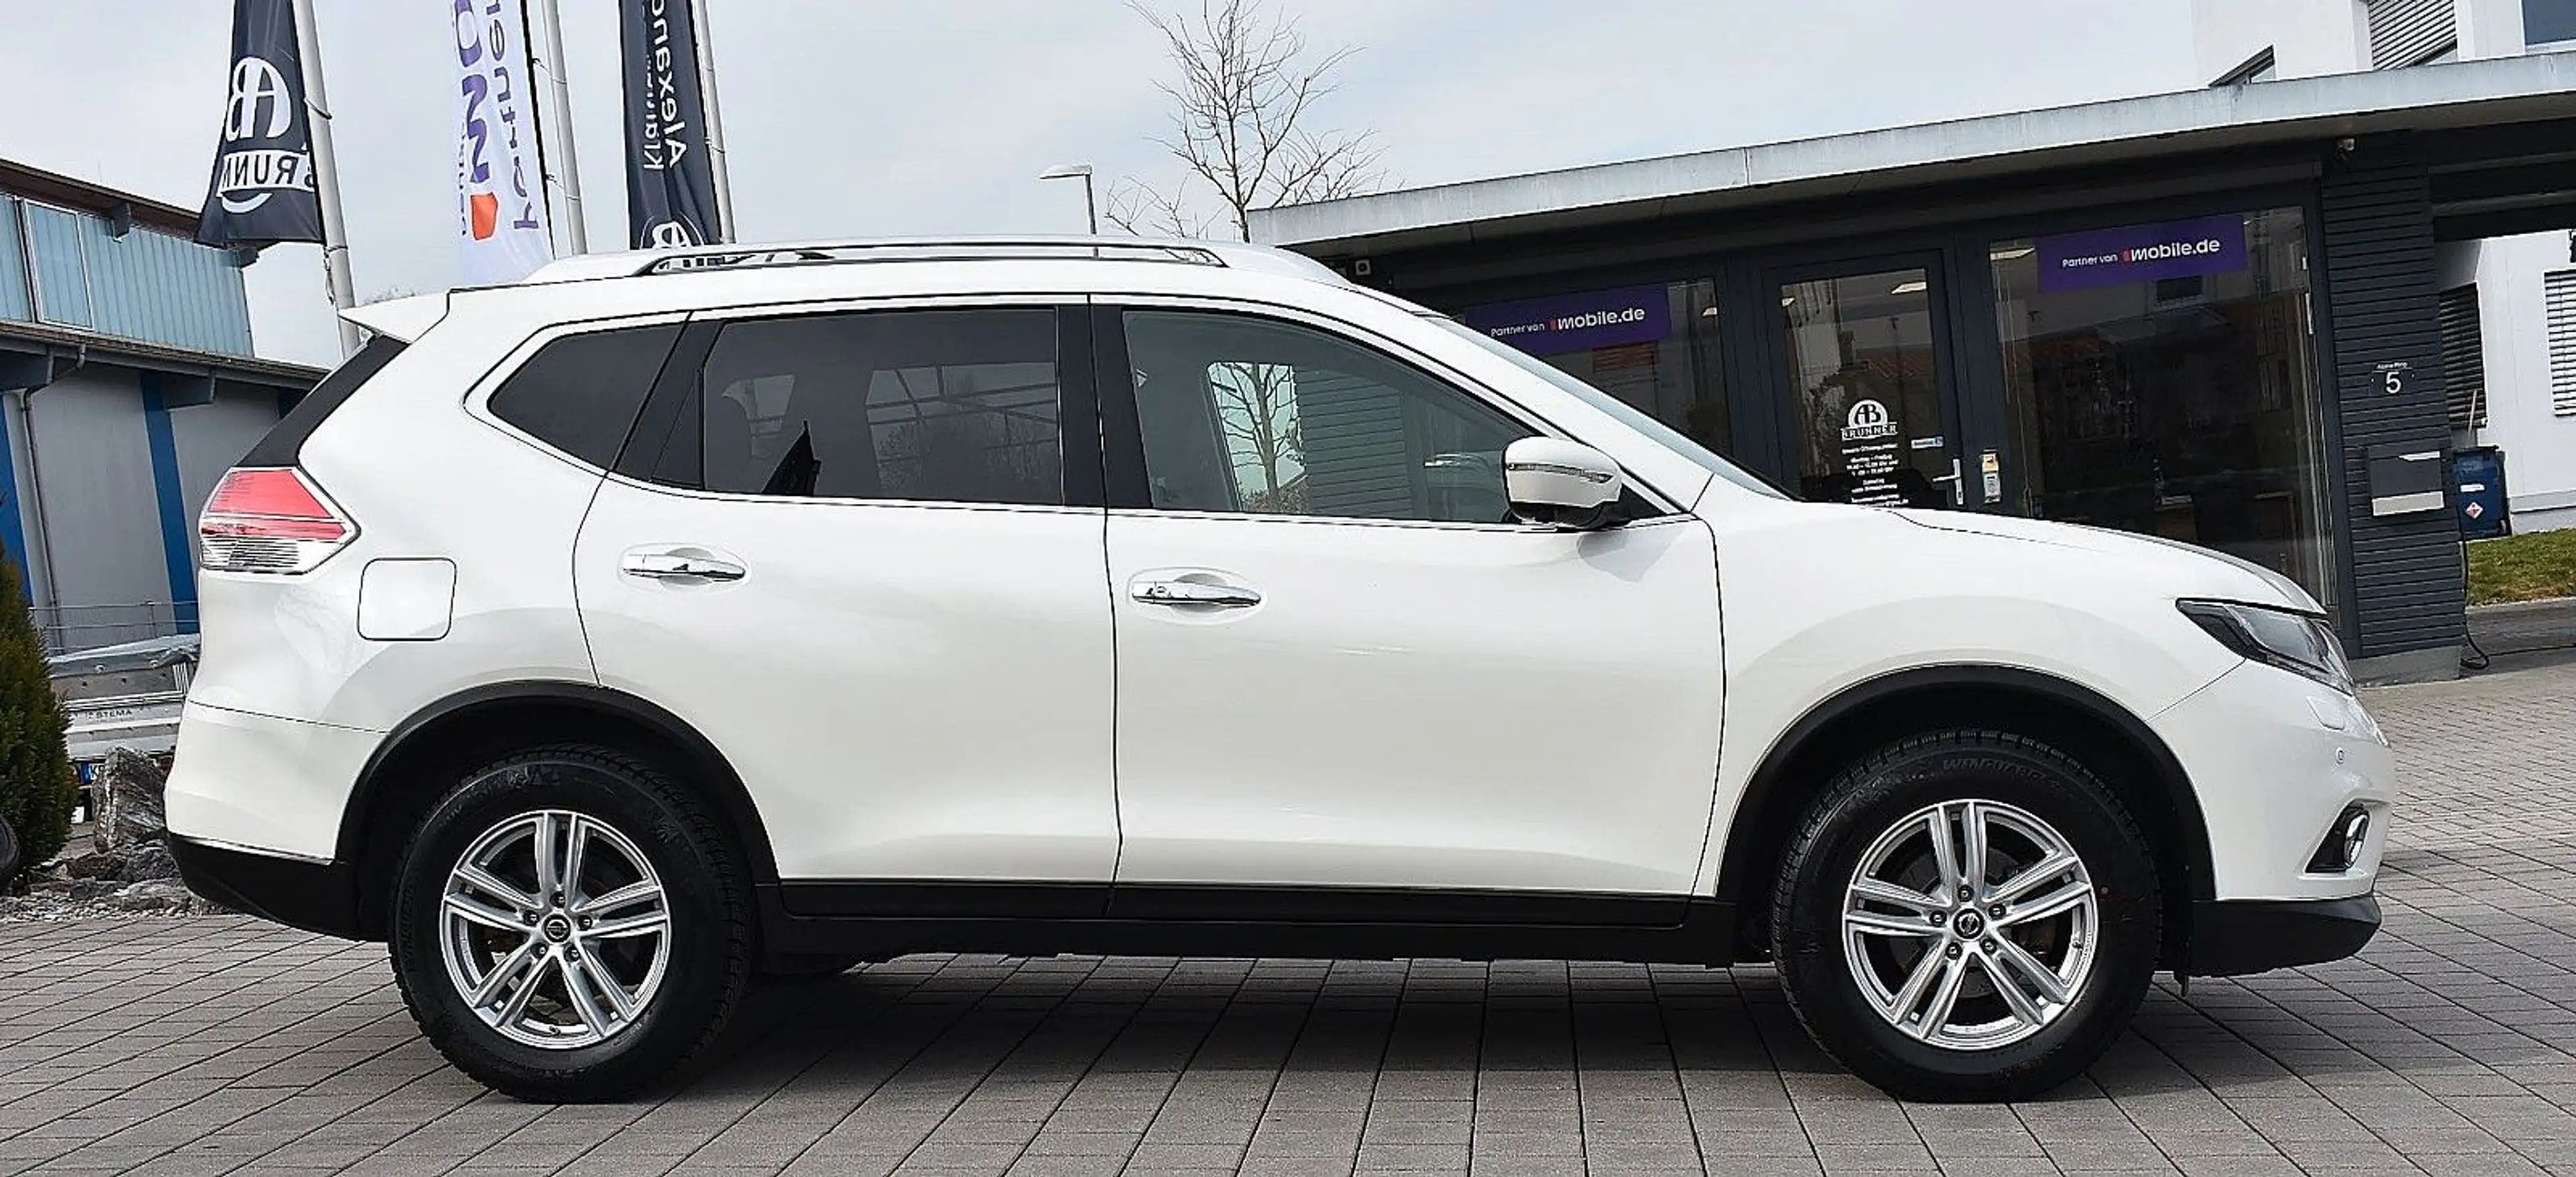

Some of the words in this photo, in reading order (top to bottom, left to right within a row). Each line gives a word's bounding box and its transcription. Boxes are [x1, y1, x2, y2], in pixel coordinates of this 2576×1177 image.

[2062, 257, 2098, 268] Partner
[2100, 254, 2118, 264] von
[2131, 239, 2220, 262] mobile.de
[1491, 325, 1525, 337] Partner
[1526, 323, 1546, 333] von
[1558, 307, 1646, 330] mobile.de
[2385, 372, 2402, 394] 5
[1841, 425, 1897, 440] BRUNNER
[96, 710, 133, 718] STEMA
